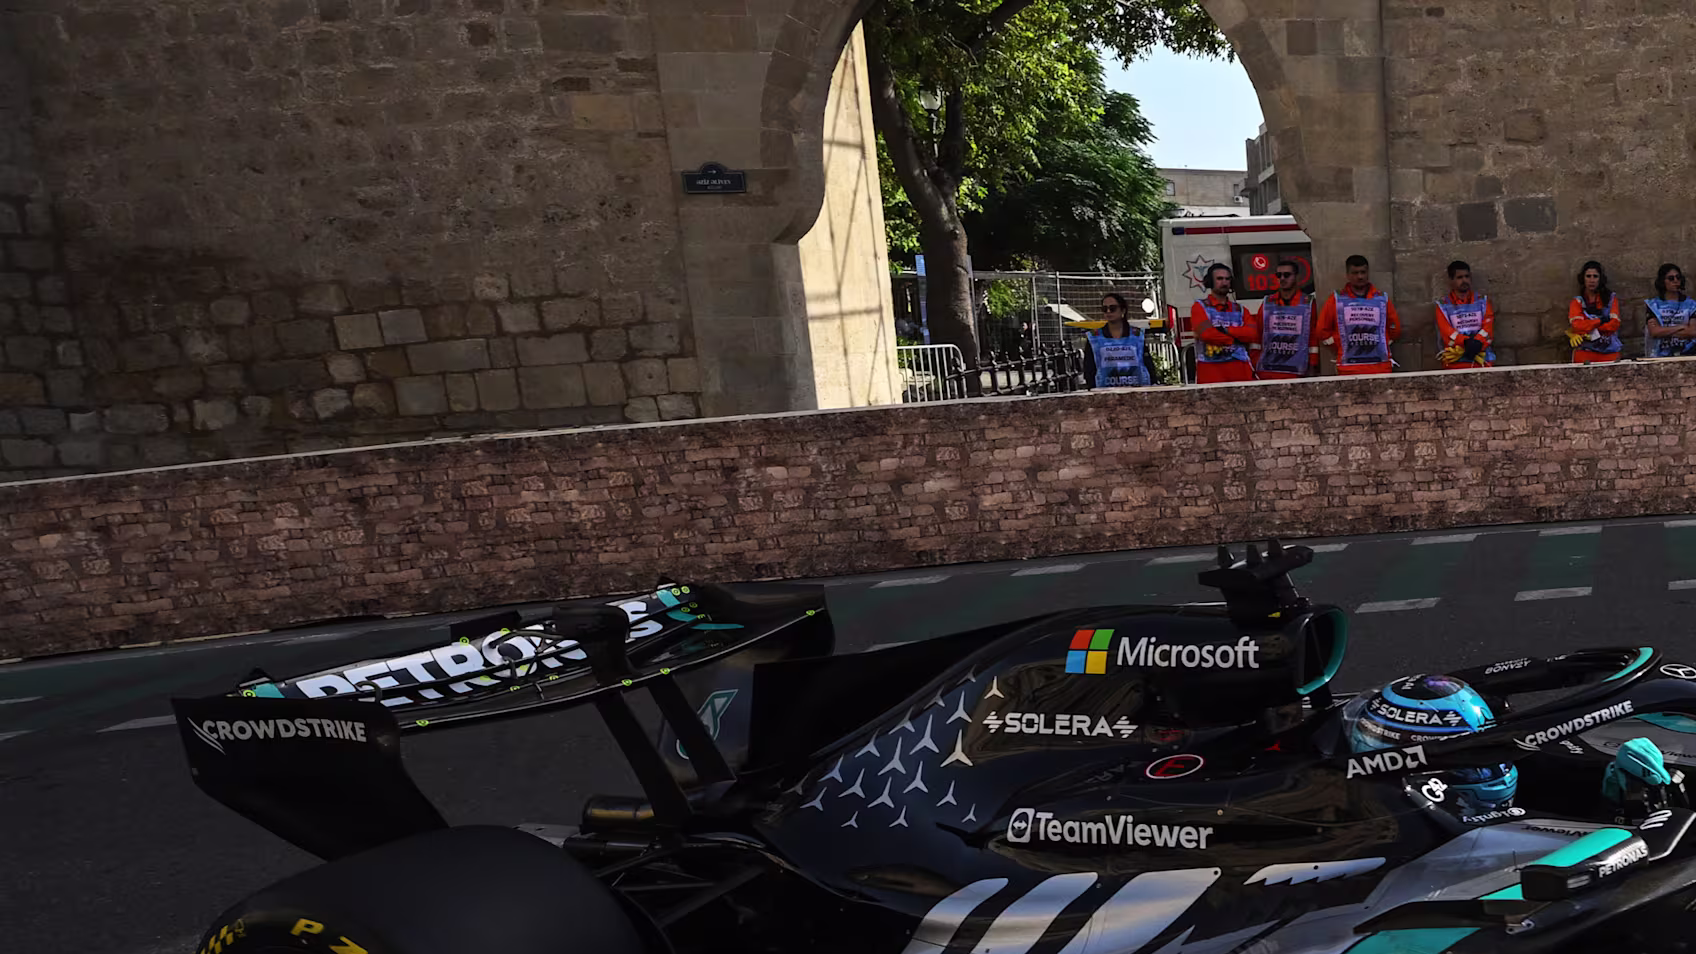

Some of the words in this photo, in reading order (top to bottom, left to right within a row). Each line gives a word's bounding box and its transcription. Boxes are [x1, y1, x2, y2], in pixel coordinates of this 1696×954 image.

[1116, 636, 1259, 669] Microsoft
[202, 708, 367, 743] CROWDSTRIKE
[1003, 712, 1115, 737] SOLERA
[1376, 703, 1443, 725] SOLERA
[1524, 700, 1633, 747] CROWDSTRIKE
[1346, 751, 1404, 779] AMD
[1035, 812, 1213, 849] TeamViewer
[1599, 846, 1648, 878] PETRONAS
[290, 918, 325, 937] P
